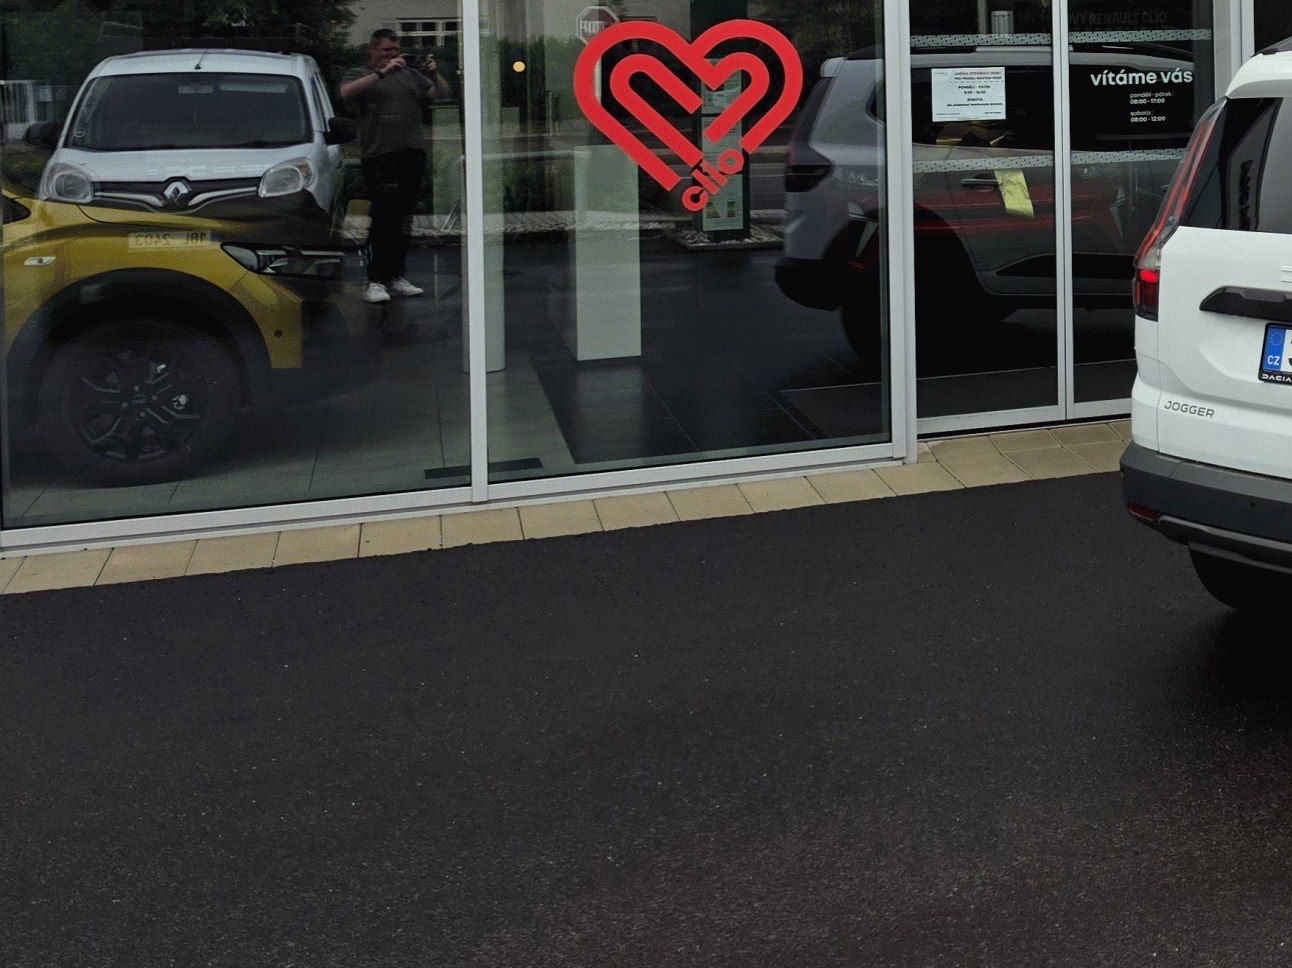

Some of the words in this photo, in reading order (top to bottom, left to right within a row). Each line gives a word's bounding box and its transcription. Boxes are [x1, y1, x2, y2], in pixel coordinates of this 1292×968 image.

[1090, 69, 1158, 86] vítáme
[1160, 67, 1193, 84] vás
[682, 148, 744, 211] clio
[1267, 354, 1280, 366] CZ
[1261, 374, 1292, 383] DACIA
[1164, 400, 1215, 420] JOGGER
